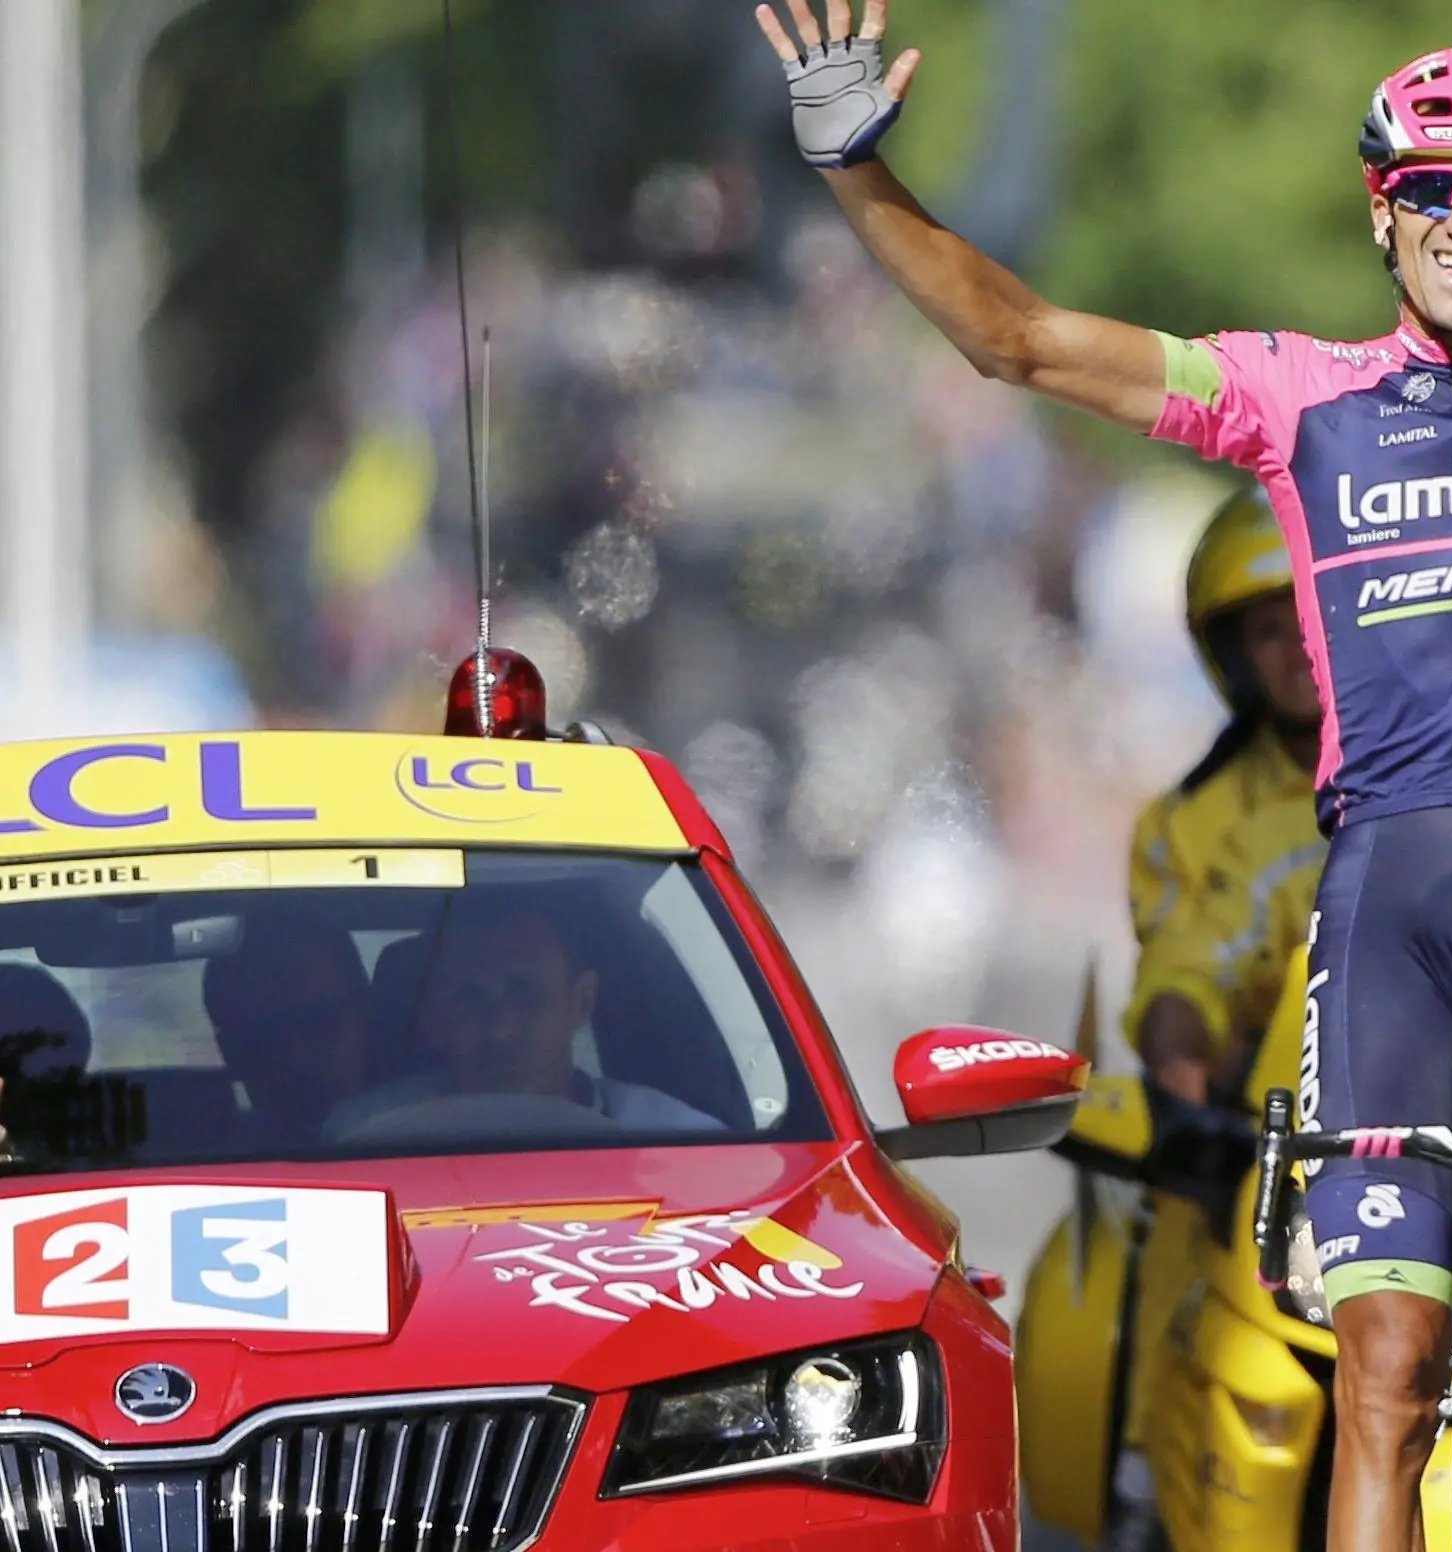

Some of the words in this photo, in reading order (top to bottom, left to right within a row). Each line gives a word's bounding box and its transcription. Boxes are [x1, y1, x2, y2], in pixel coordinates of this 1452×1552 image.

[1379, 426, 1438, 447] LAMITAL
[1347, 527, 1401, 546] lamiere
[0, 741, 317, 834] CL
[411, 756, 563, 793] LCL
[0, 864, 150, 891] FFICIEL
[350, 854, 379, 880] 1
[928, 1040, 1070, 1072] ŠKODA
[42, 1221, 129, 1309] 2
[200, 1217, 288, 1300] 3
